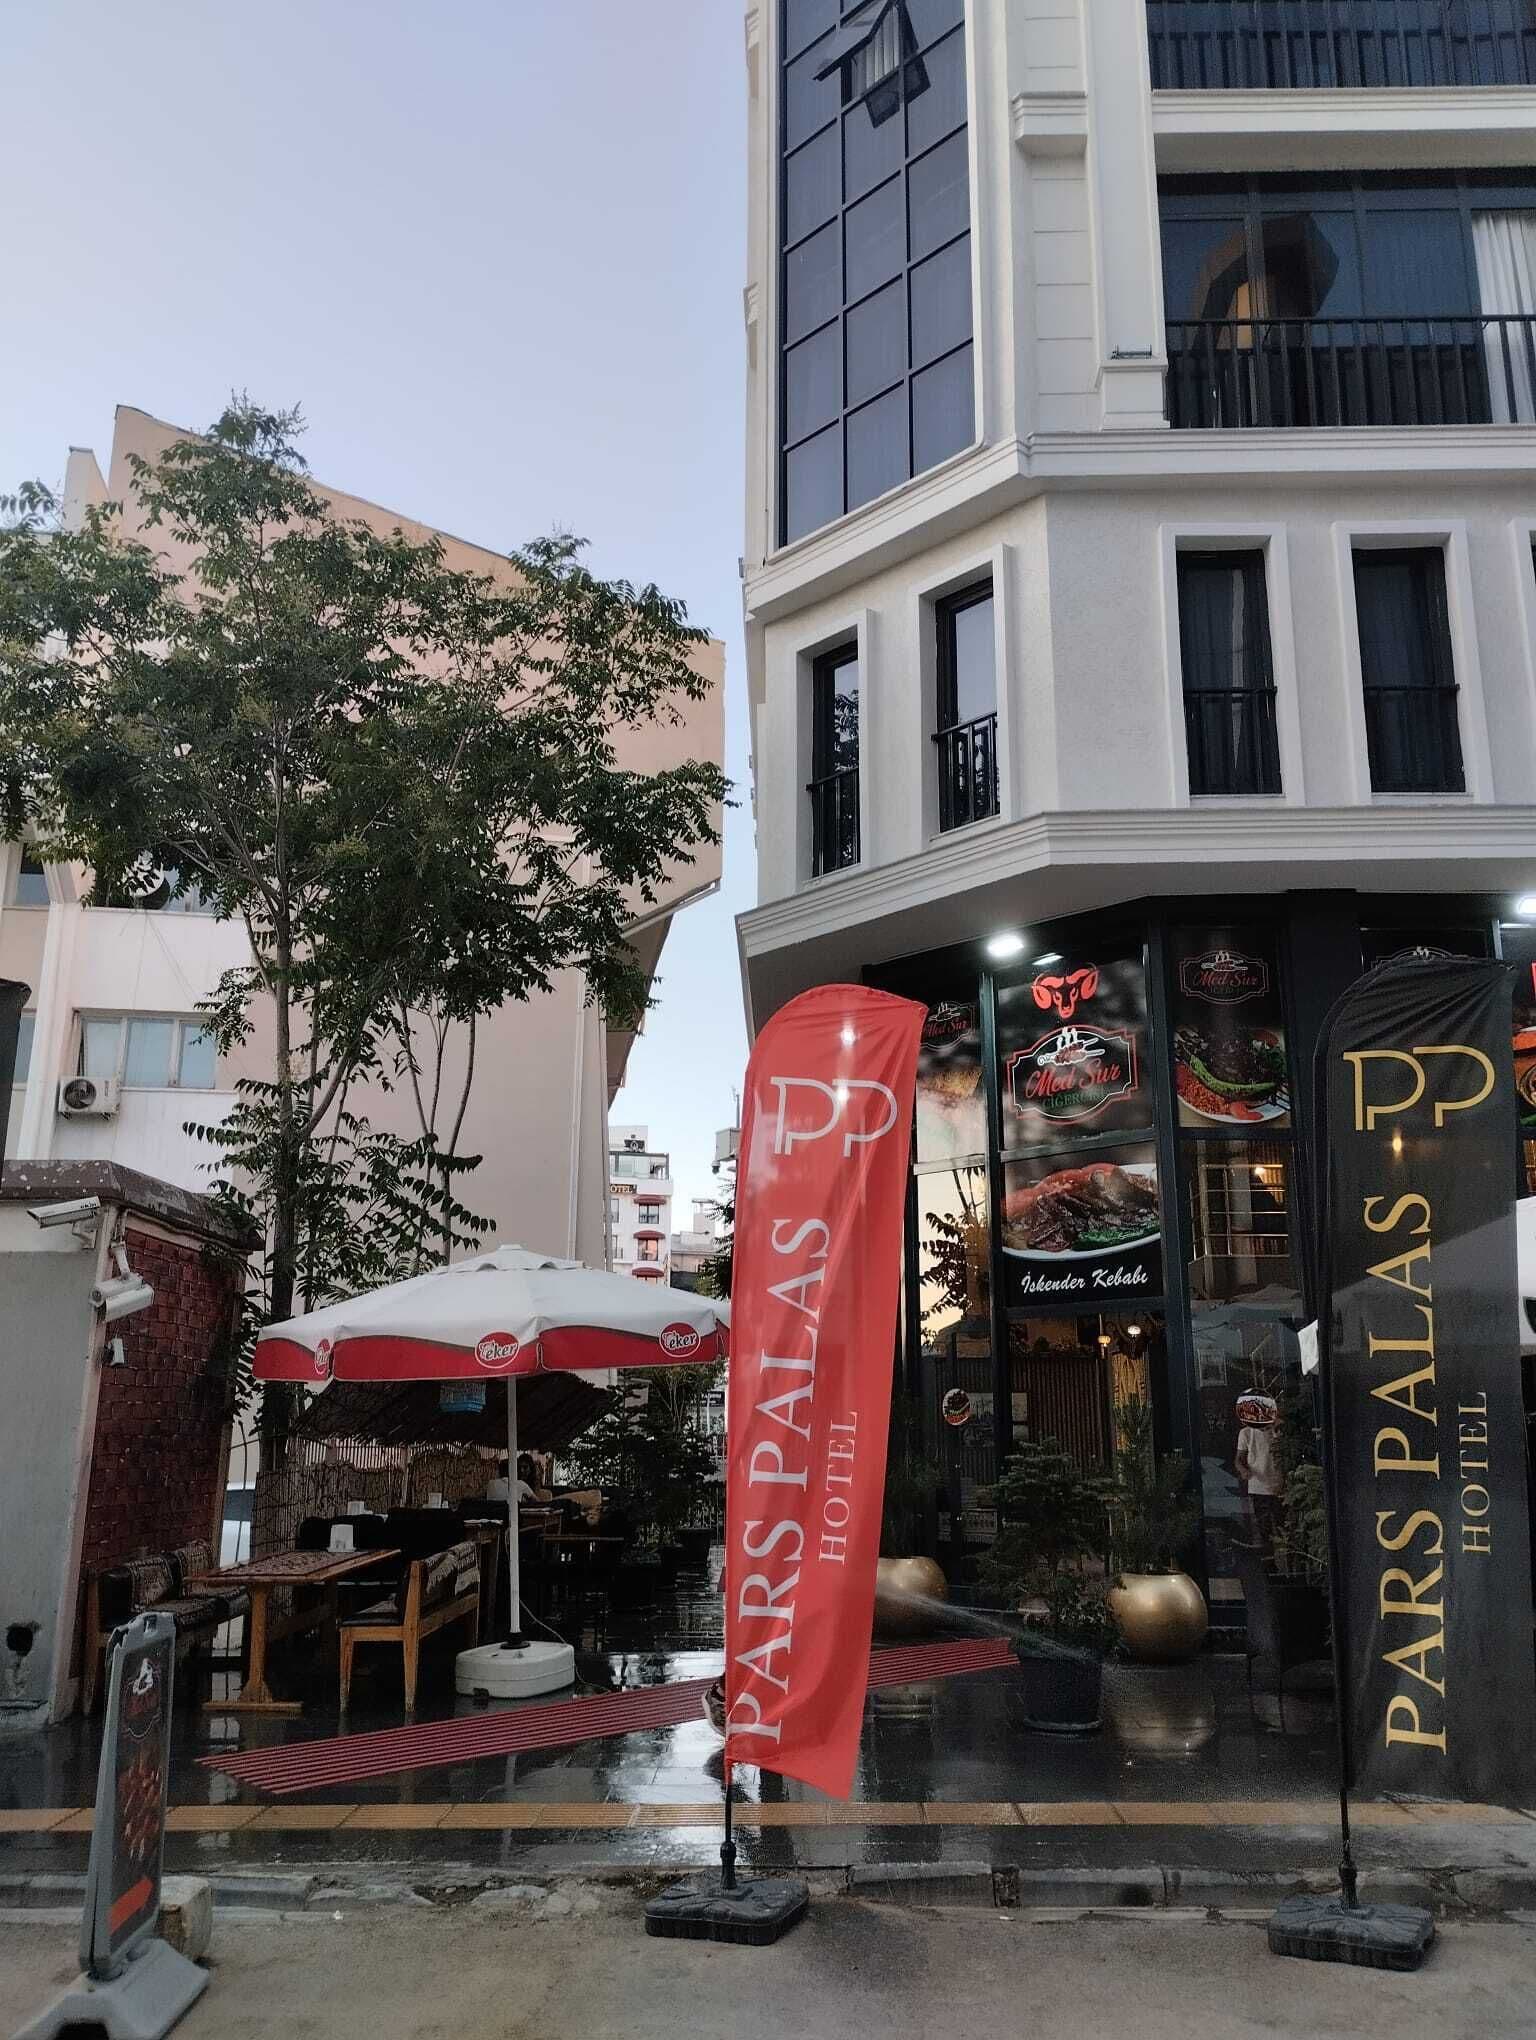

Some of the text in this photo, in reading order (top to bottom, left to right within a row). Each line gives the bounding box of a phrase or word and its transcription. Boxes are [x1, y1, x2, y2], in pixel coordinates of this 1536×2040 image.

[1025, 1066, 1076, 1098] Med
[725, 1217, 831, 1744] PARS PALAS
[819, 1411, 858, 1565] HOTEL
[1363, 1193, 1447, 1756] PARS PALAS
[1458, 1391, 1491, 1553] HOTEL
